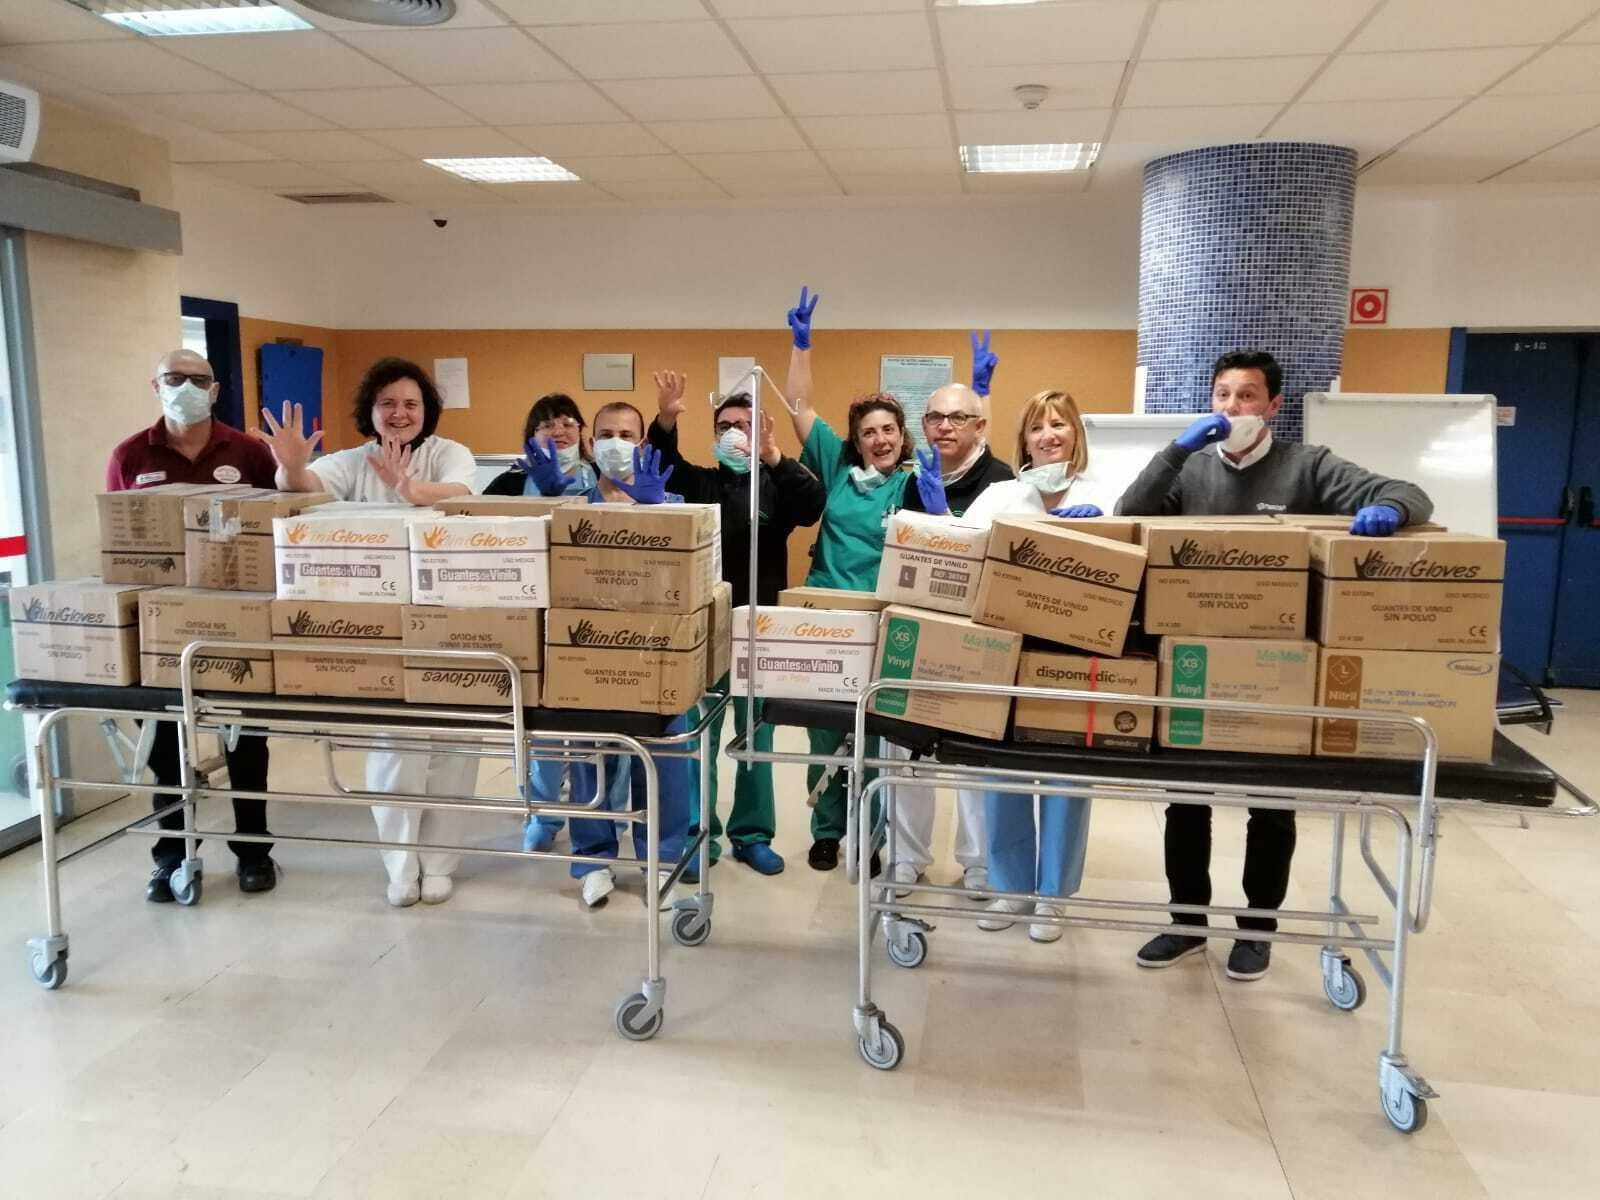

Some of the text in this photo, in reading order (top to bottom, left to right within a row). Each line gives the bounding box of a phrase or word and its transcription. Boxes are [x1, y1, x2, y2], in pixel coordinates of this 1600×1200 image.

[1025, 600, 1073, 618] SIN POLVO
[1199, 600, 1249, 609] SIN POLVO
[1383, 613, 1437, 622] SIN POLVO
[895, 632, 910, 642] XS
[887, 654, 911, 669] Vinyl
[595, 677, 639, 686] SIN POLVO
[1176, 684, 1202, 697] Vinyl
